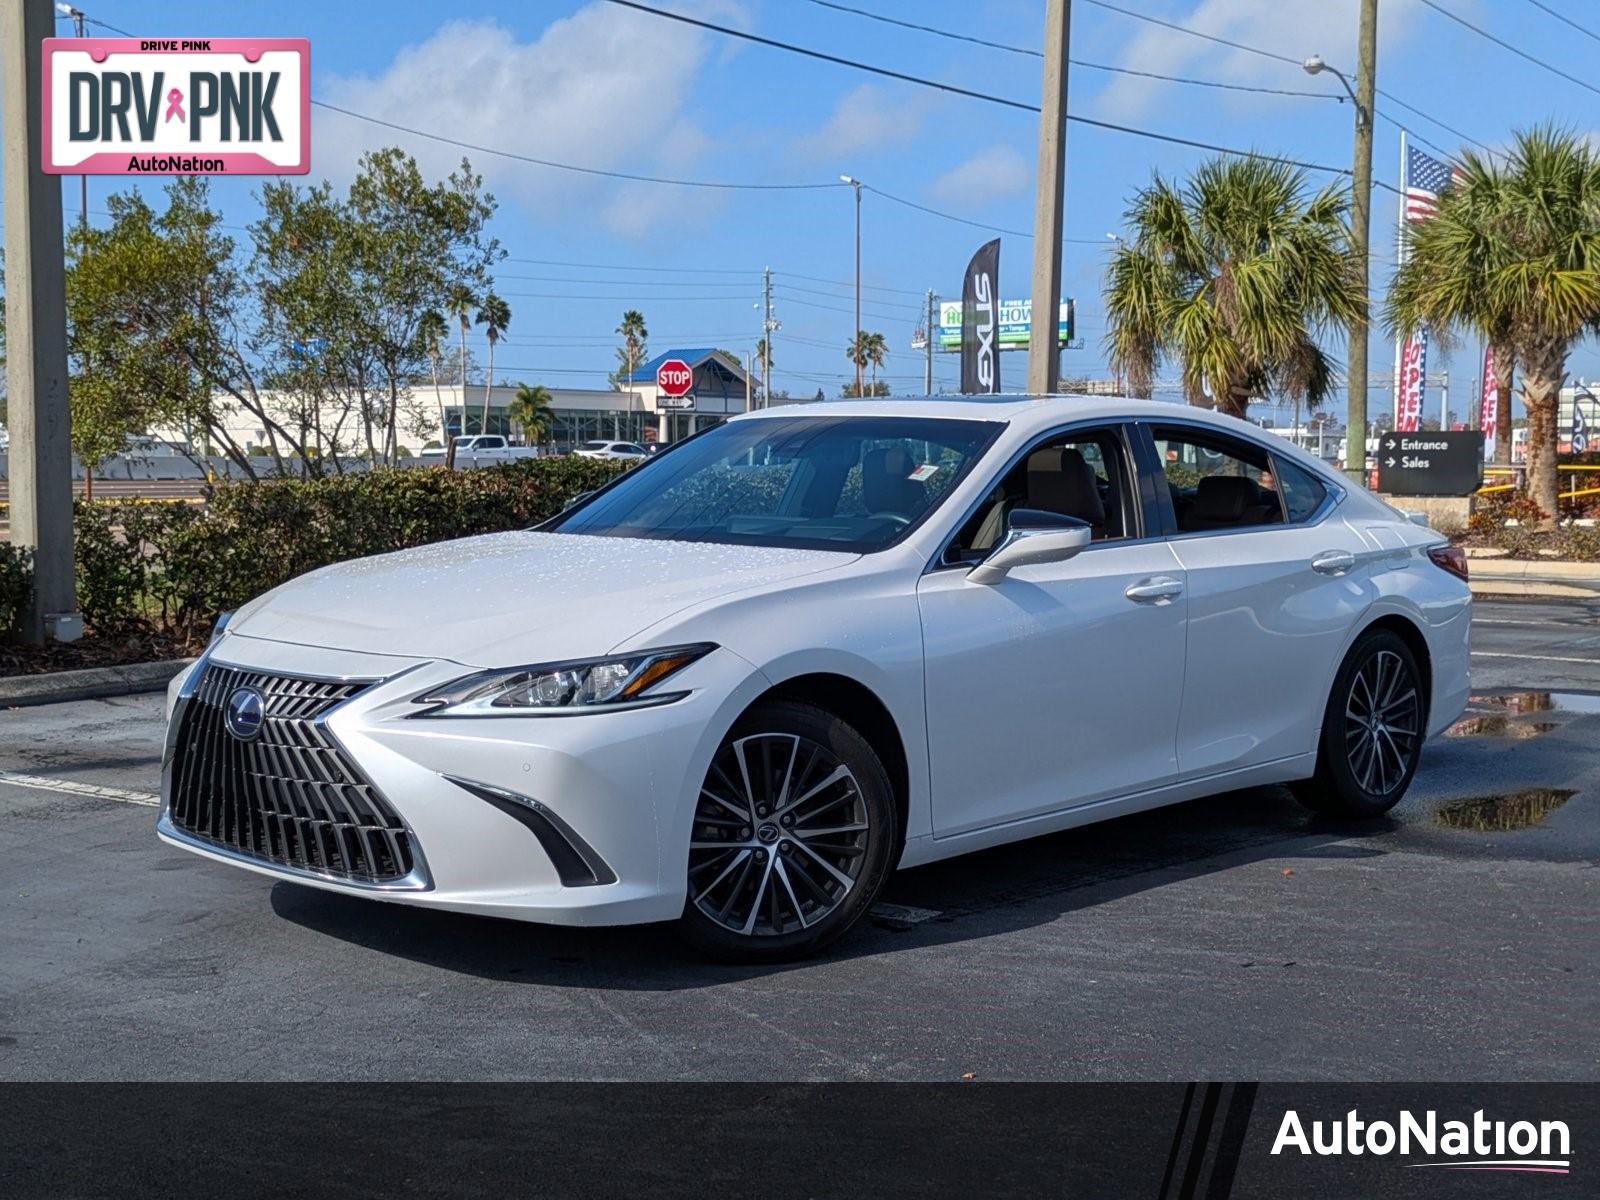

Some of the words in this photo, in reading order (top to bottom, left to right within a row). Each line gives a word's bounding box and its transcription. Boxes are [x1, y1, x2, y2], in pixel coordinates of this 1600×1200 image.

[1000, 308, 1031, 322] HOW
[974, 272, 994, 393] EXUS
[660, 370, 690, 385] STOP
[1404, 343, 1421, 432] OPEN
[1486, 379, 1498, 440] PEN
[1401, 438, 1448, 450] Entrance
[1401, 456, 1430, 468] Sales
